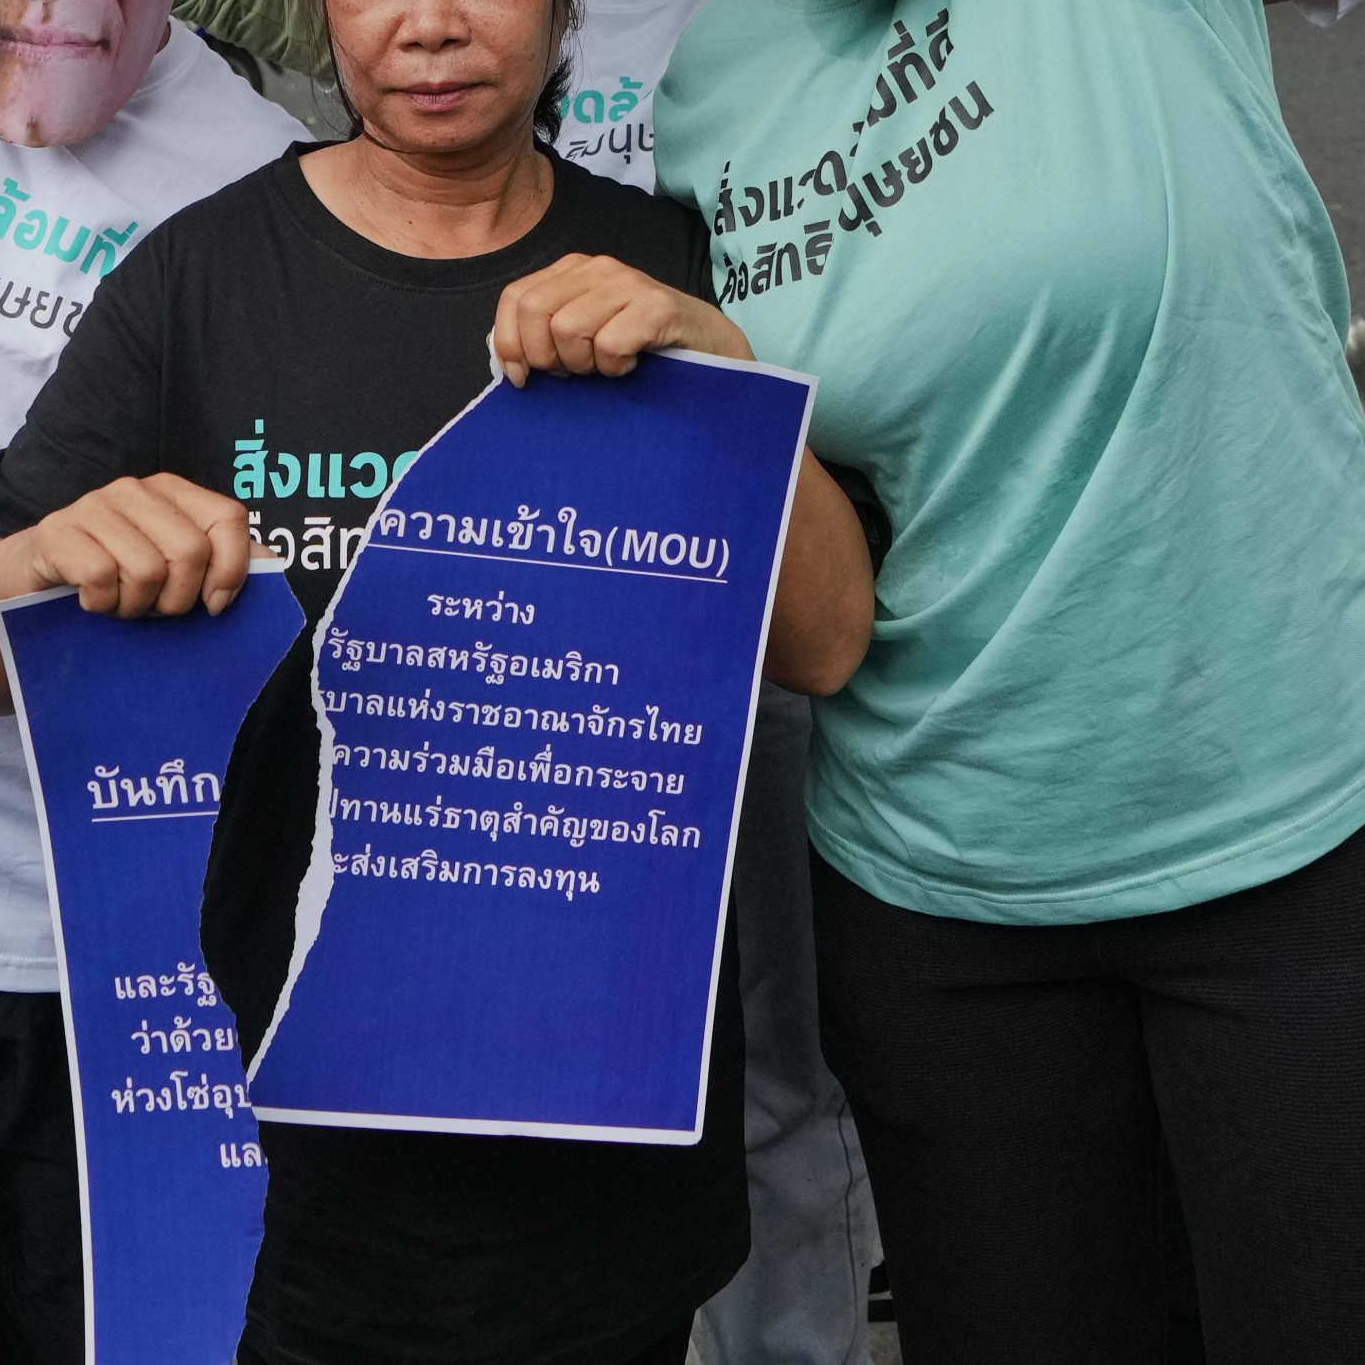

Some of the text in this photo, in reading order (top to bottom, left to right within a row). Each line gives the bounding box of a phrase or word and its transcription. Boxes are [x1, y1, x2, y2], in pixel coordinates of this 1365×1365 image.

[379, 504, 730, 577] ความเข้าใจ(MOU)
[426, 590, 535, 625] ระหว่าง
[327, 627, 620, 686] รัฐบาลสหรัฐอเมริกา
[319, 688, 703, 746] บาลแห่งราชอาณาจักรไทย
[87, 758, 220, 810] บันทึก
[332, 741, 685, 795] ความร่วมมือเพื่อกระจาย
[131, 1016, 234, 1054] ว่าด้วย
[220, 1142, 268, 1168] แล
